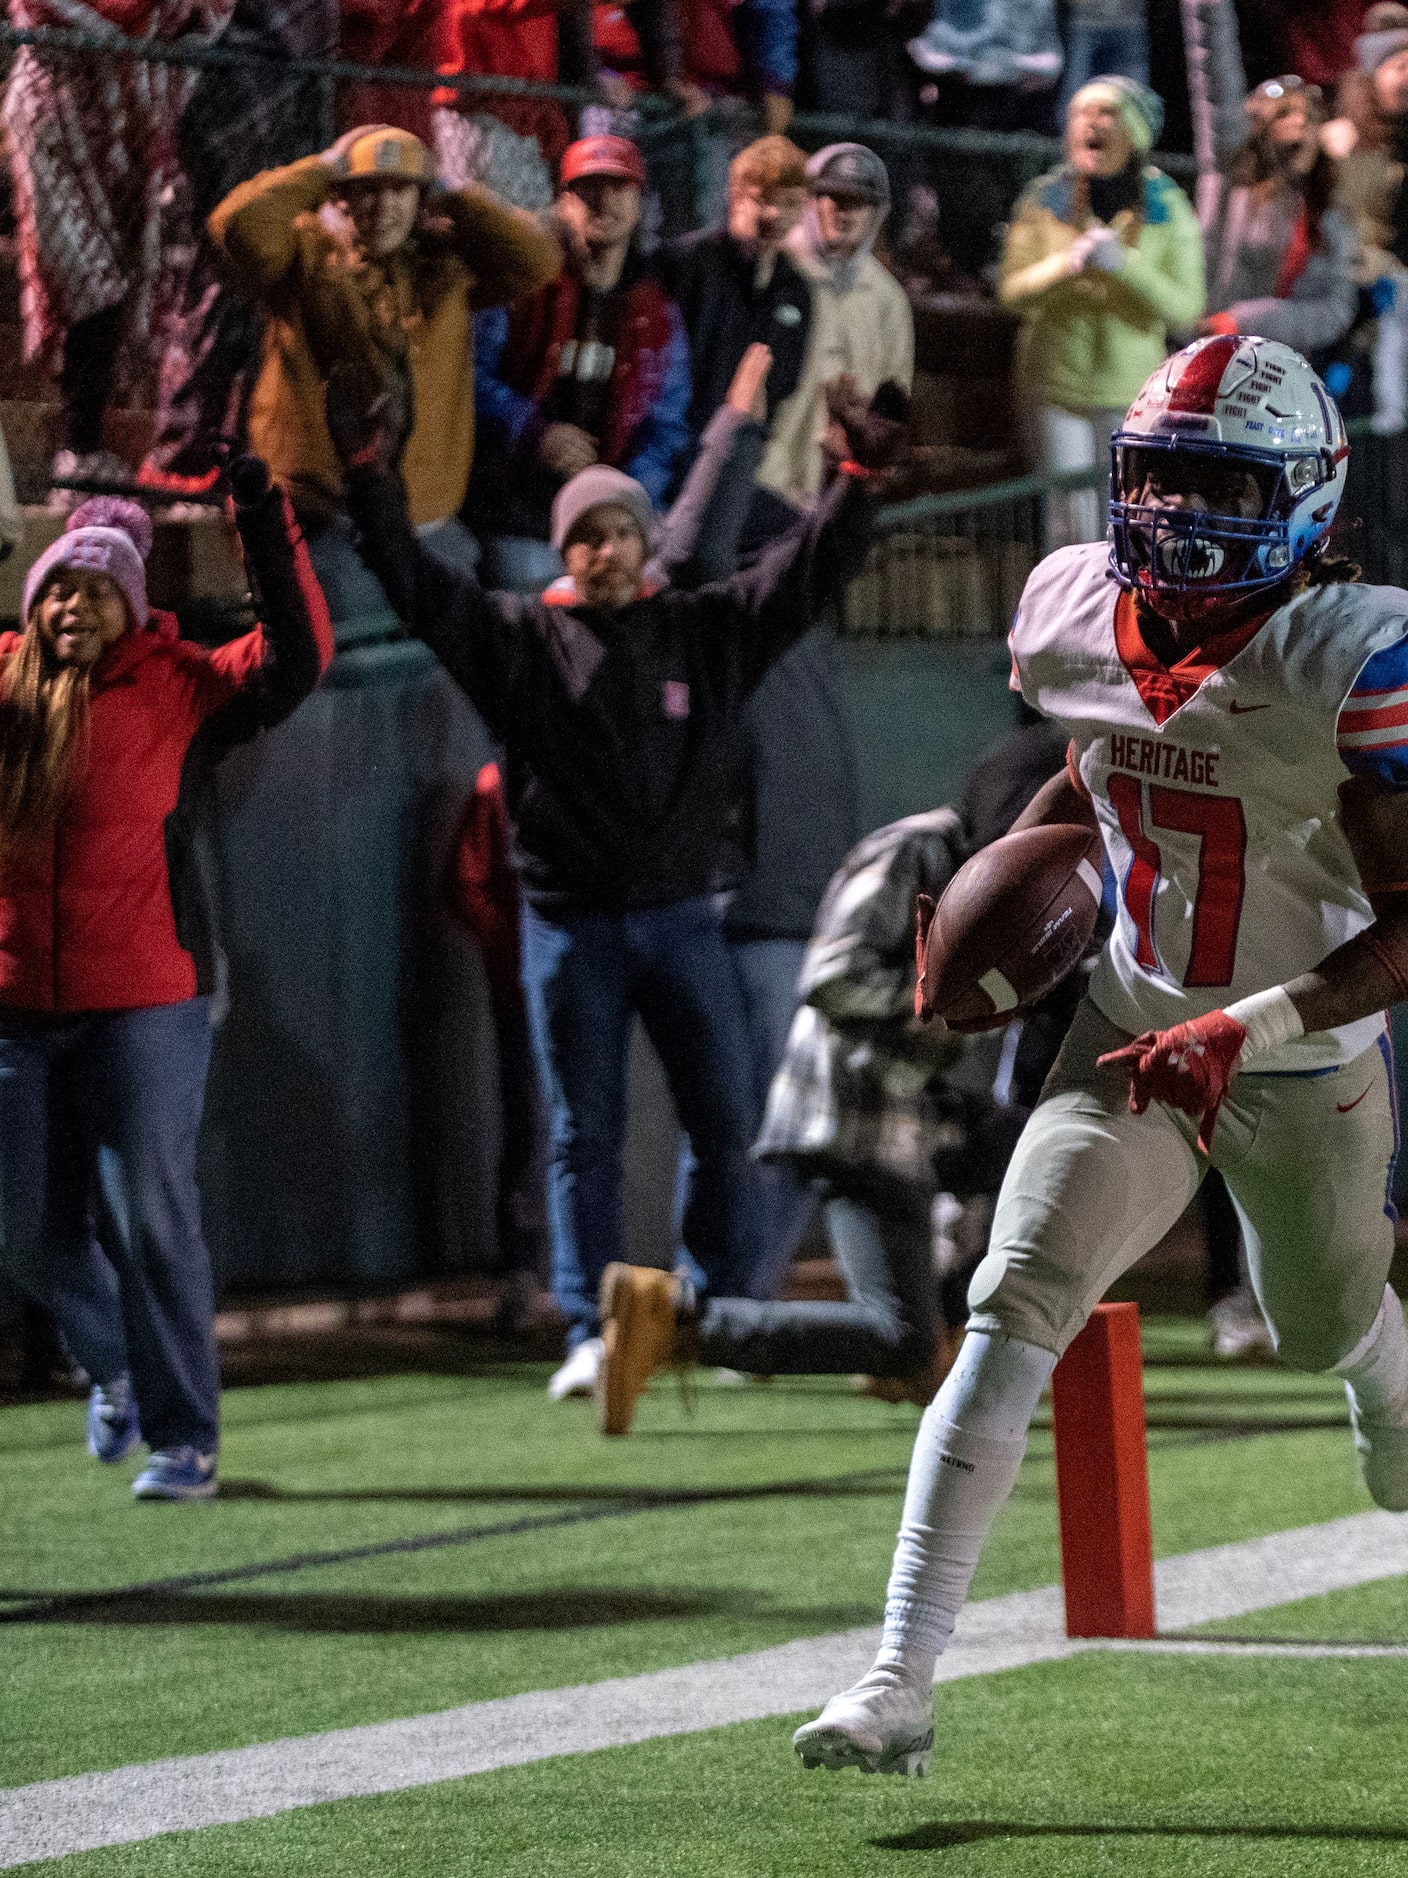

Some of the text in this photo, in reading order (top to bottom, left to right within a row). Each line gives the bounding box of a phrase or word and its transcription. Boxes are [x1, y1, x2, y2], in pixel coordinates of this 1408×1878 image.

[1260, 371, 1283, 386] FIGHT
[1250, 380, 1272, 394] FIGHT
[1238, 391, 1262, 407] FIGHT
[1110, 733, 1220, 788] HERITAGE
[1106, 771, 1248, 988] 17
